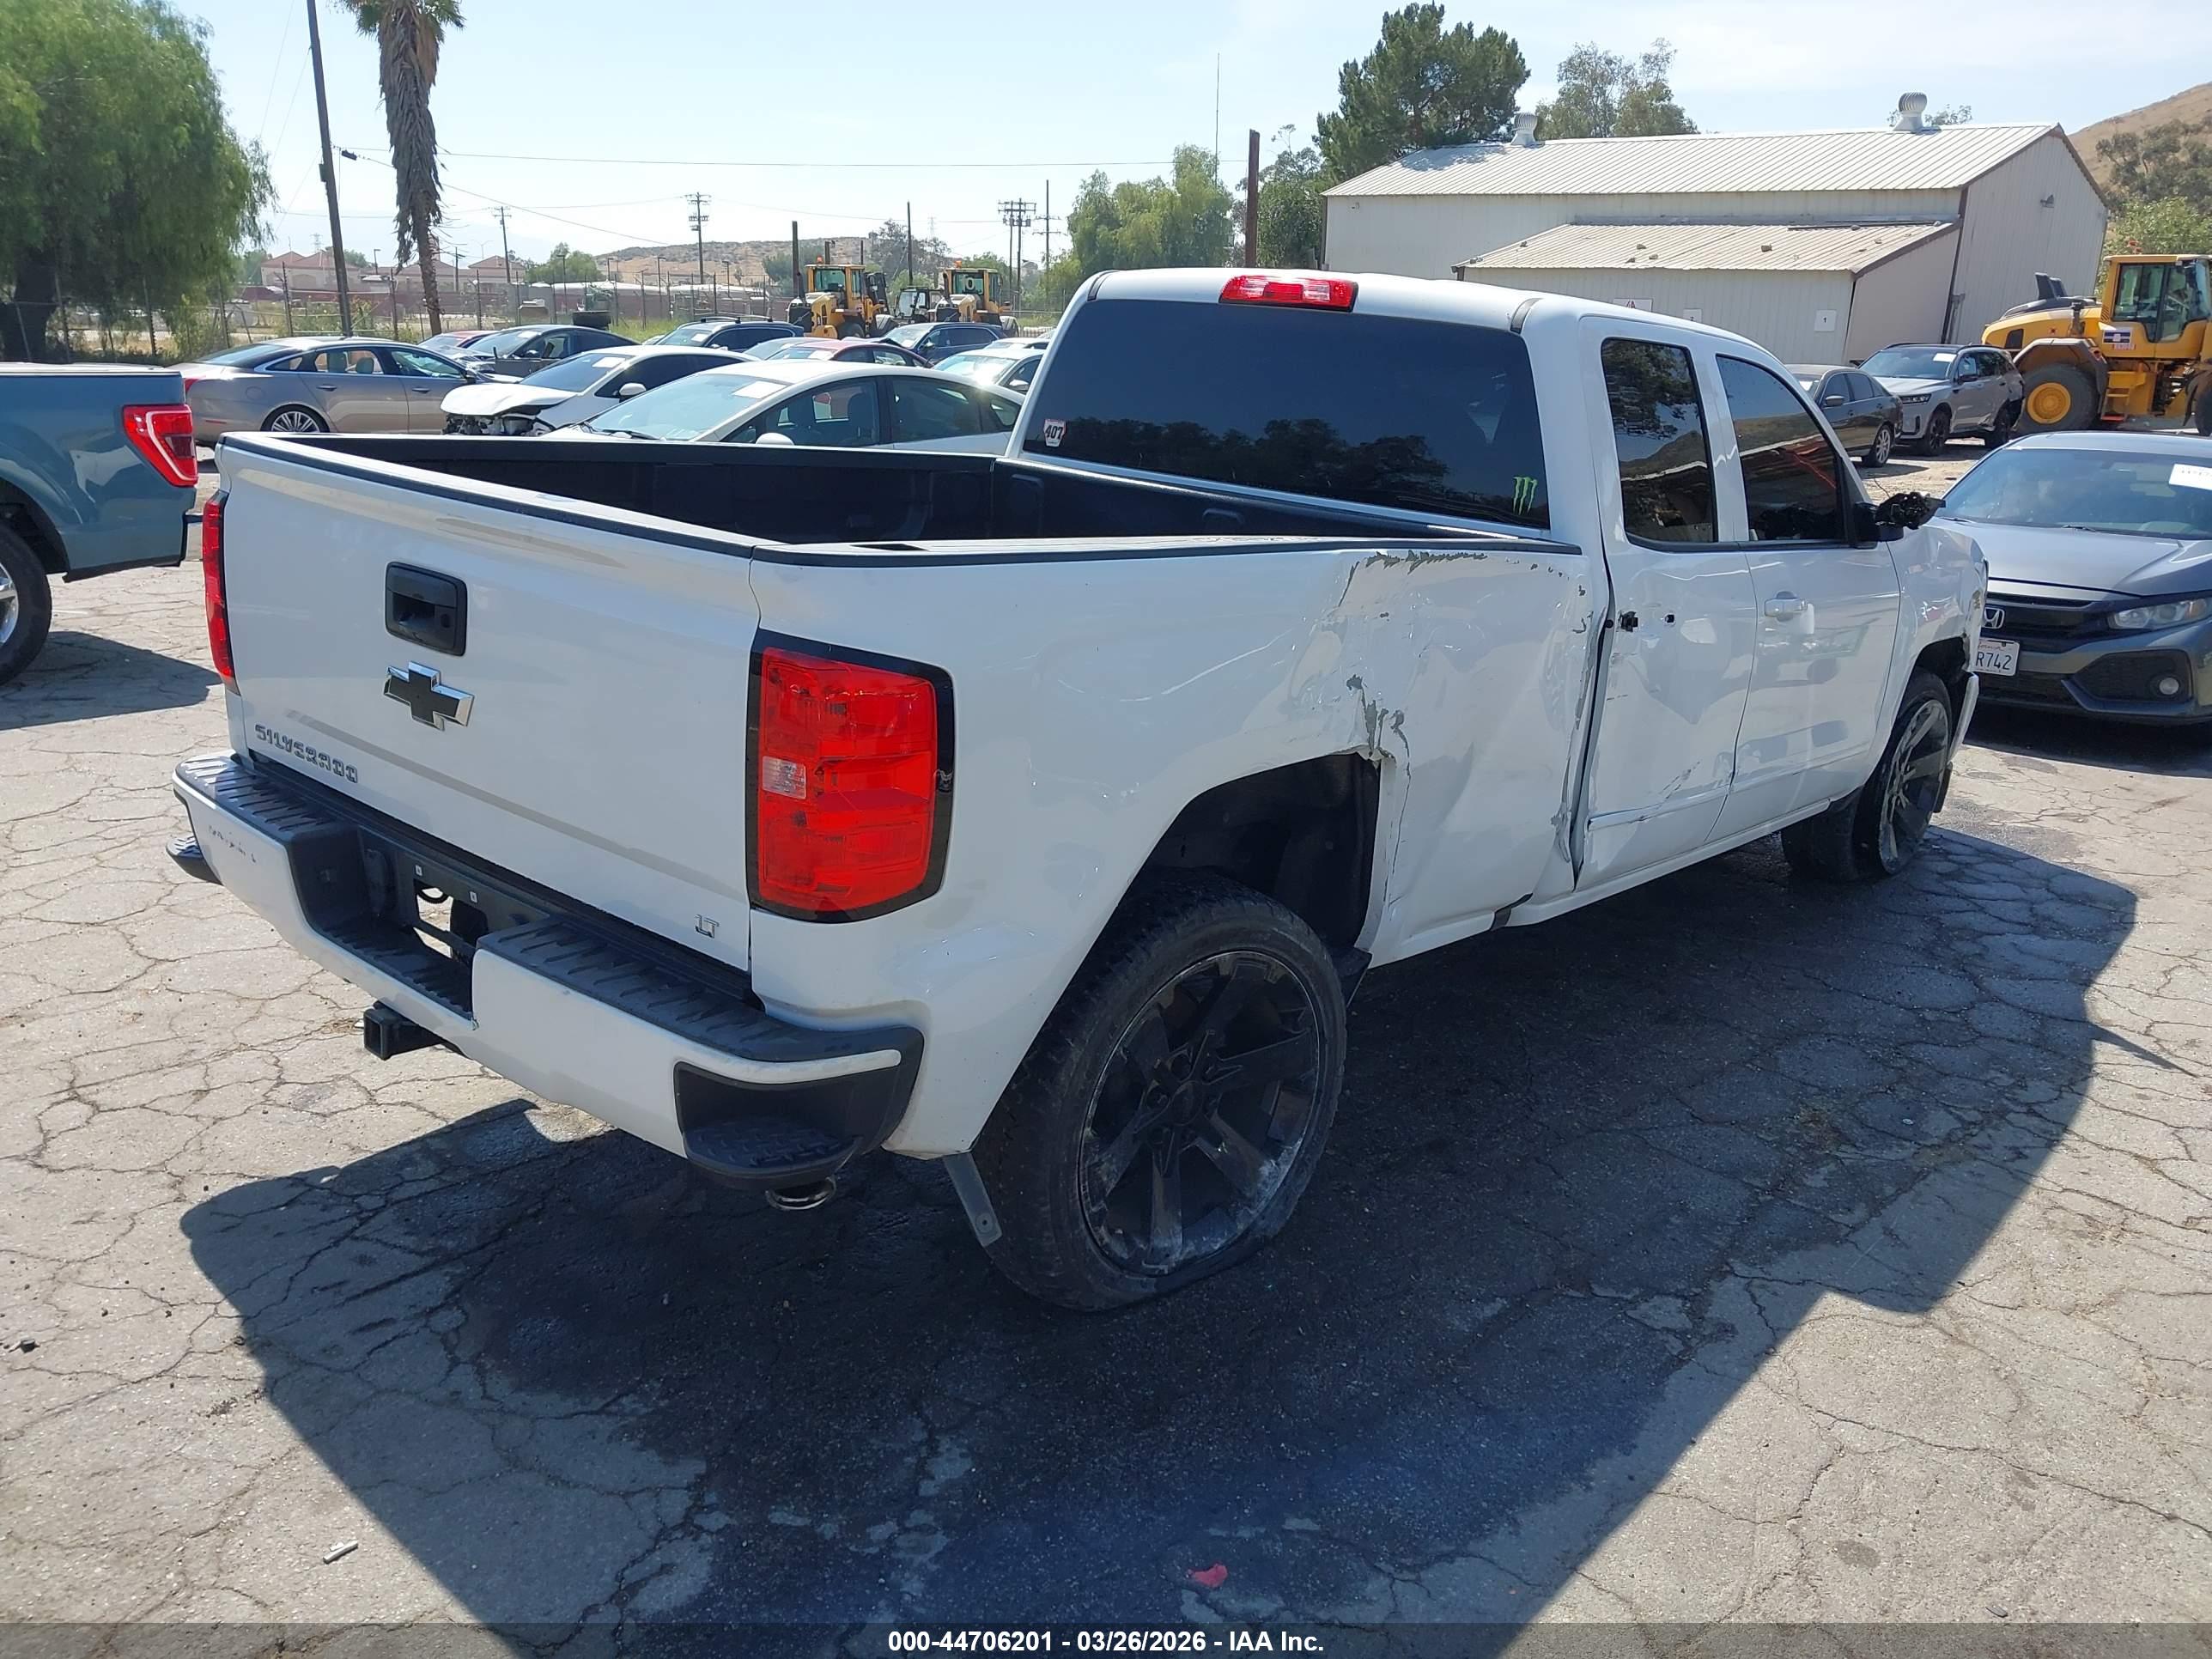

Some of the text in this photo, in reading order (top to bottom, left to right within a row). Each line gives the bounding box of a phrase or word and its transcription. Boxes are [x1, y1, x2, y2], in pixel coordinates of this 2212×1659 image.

[1045, 424, 1064, 440] 407
[1975, 651, 2012, 671] R742
[255, 724, 358, 784] SILVERADO
[694, 914, 720, 939] LT
